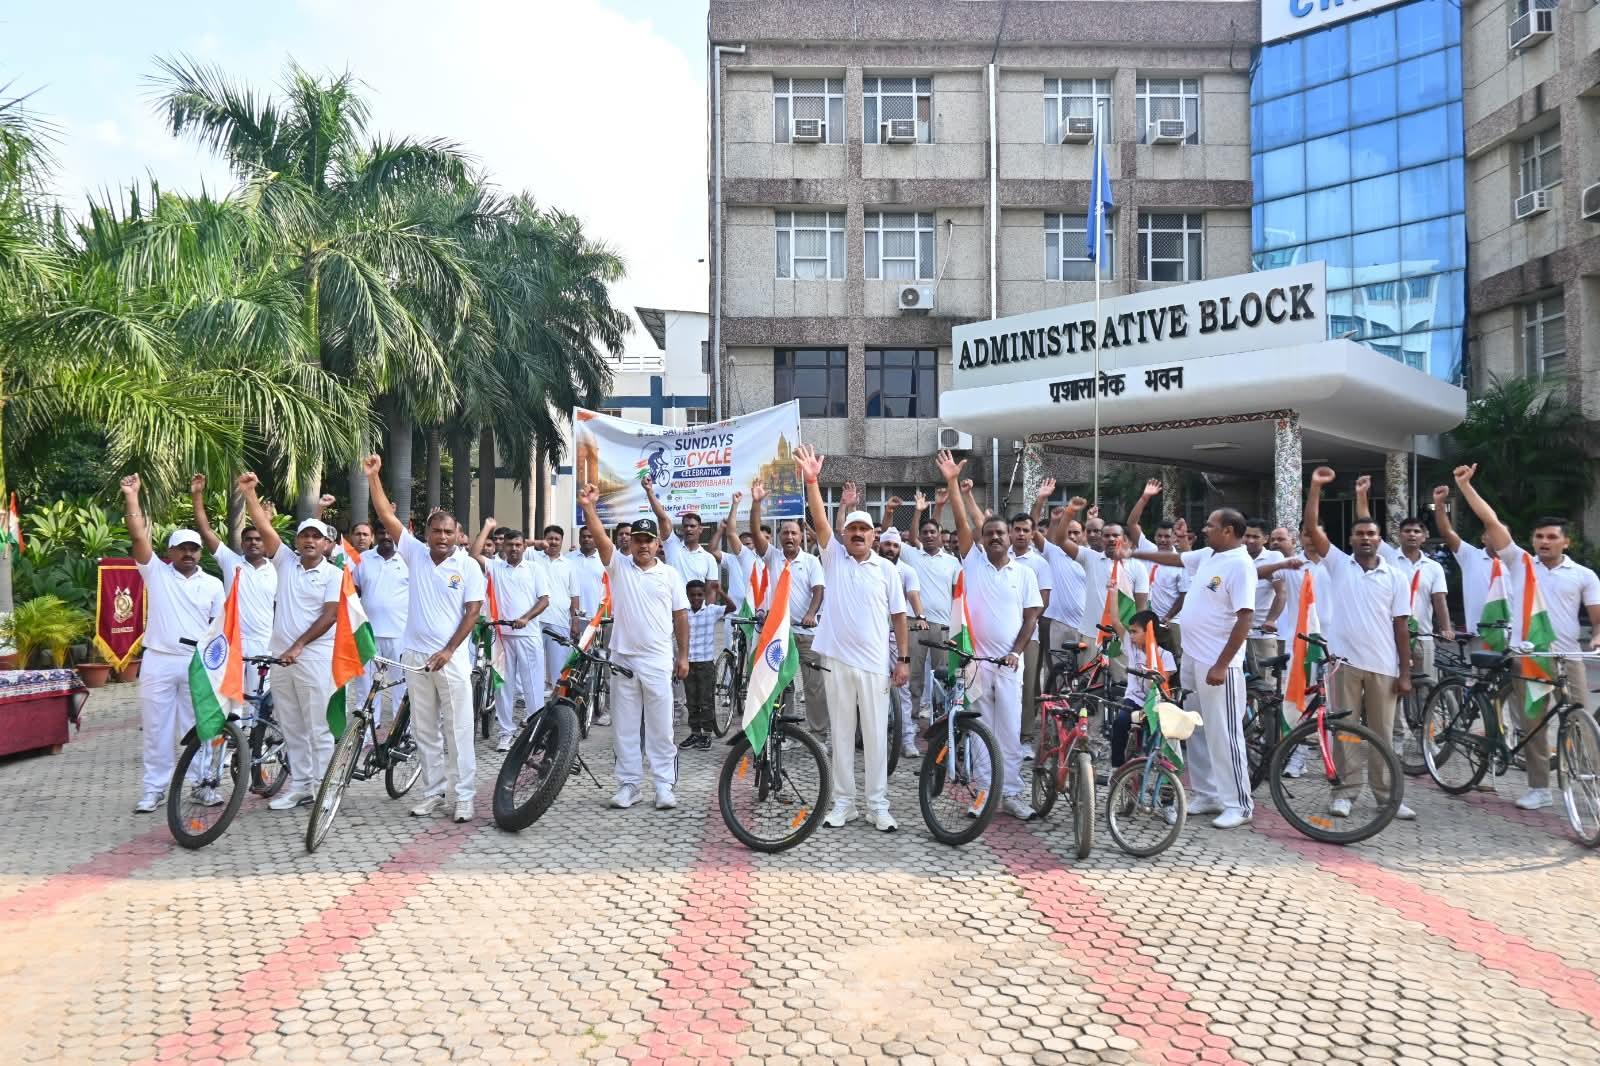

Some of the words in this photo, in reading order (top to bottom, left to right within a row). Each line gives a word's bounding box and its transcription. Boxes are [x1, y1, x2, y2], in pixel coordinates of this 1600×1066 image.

[959, 304, 1188, 370] ADMINISTRATIVE
[1199, 283, 1315, 334] BLOCK
[1145, 367, 1183, 392] भवन
[675, 434, 734, 450] SUNDAYS
[674, 457, 686, 465] ON
[687, 447, 732, 467] CYCLE
[681, 468, 722, 477] CELEBRATING
